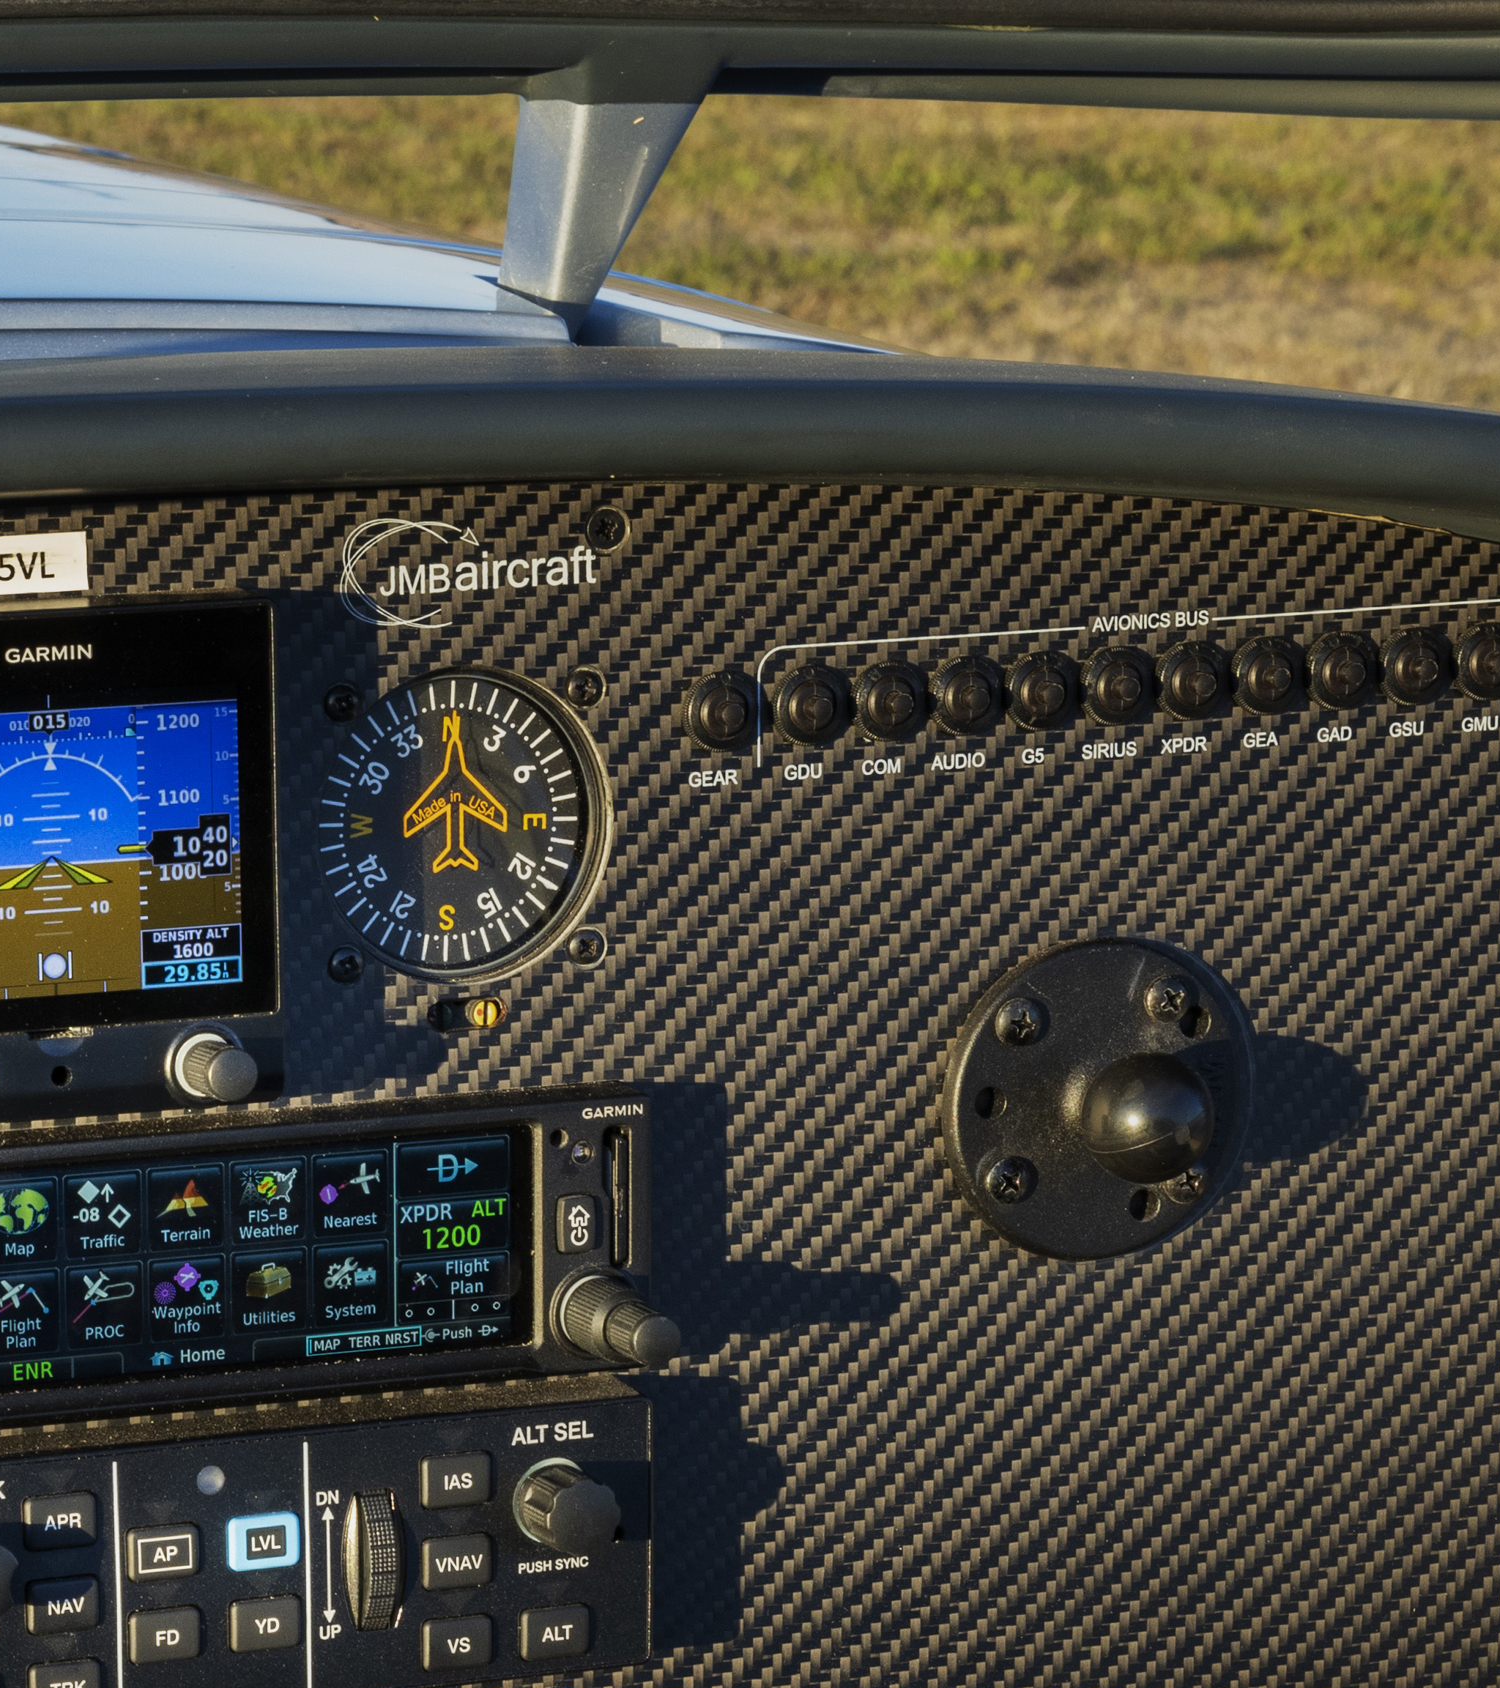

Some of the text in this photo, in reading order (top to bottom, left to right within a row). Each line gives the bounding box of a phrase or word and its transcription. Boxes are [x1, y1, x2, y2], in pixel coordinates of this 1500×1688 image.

[1091, 609, 1211, 633] AVIONICS BUS
[4, 643, 93, 664] GARMIN
[155, 712, 201, 732] 1200
[1461, 715, 1500, 733] GMU
[1317, 724, 1353, 743] GAD
[1081, 739, 1137, 760] SIRIUS
[1161, 735, 1209, 755] XPDR
[930, 751, 987, 772] AUDIO
[1021, 746, 1046, 765] G5
[783, 762, 823, 782] GDU
[861, 757, 903, 776] COM
[687, 769, 739, 789] GEAR
[410, 791, 497, 826] Made in USA
[151, 927, 229, 943] DENSITY ALT
[581, 1104, 644, 1121] GARMIN
[238, 1219, 299, 1240] Weather
[323, 1211, 378, 1230] Nearest
[79, 1232, 126, 1251] Traffic
[421, 1224, 481, 1251] 1200
[4, 1241, 36, 1261] Map
[242, 1306, 296, 1325] Utilities
[179, 1343, 225, 1365] Home
[511, 1420, 595, 1446] ALT SEL
[44, 1510, 82, 1531] APR
[251, 1533, 281, 1553] LVL
[435, 1553, 484, 1573] VNAV
